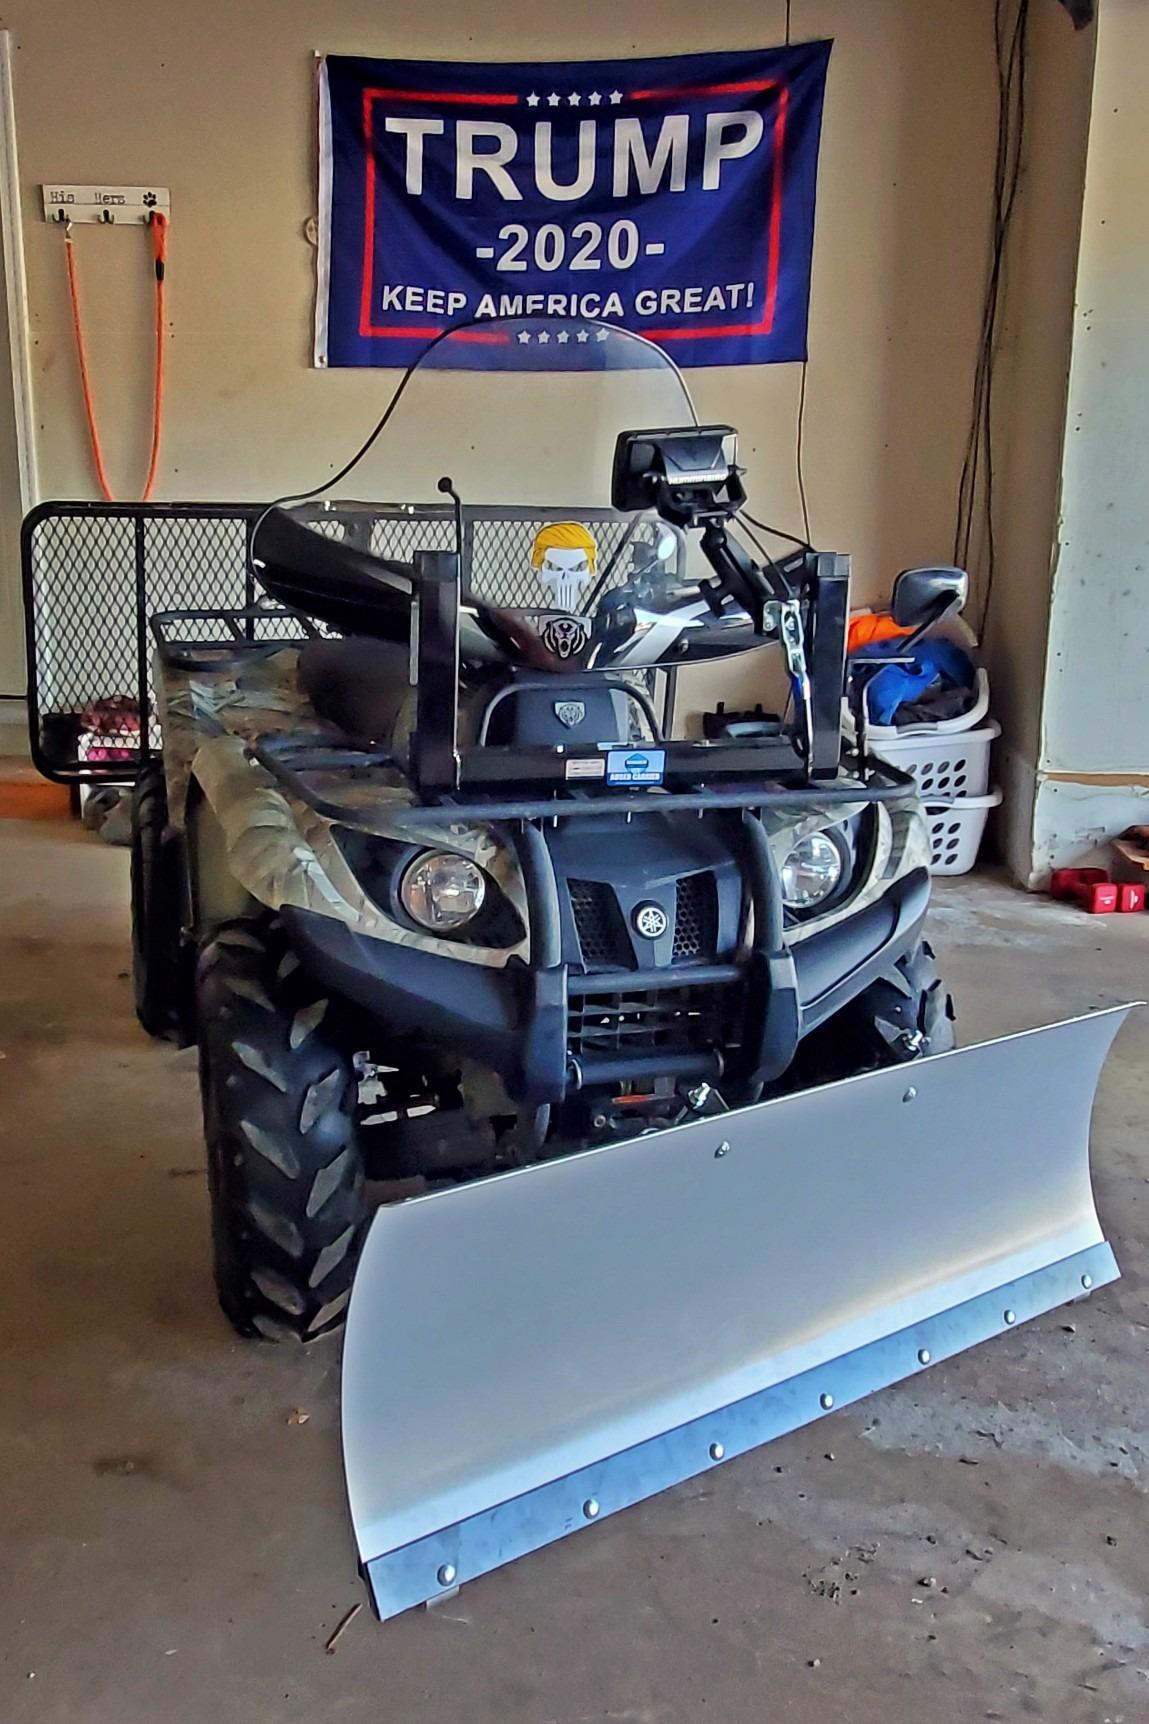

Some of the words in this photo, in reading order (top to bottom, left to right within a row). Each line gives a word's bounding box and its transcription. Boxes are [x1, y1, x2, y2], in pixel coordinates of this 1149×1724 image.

[385, 110, 764, 201] TRUMP
[382, 284, 467, 316] KEEP
[635, 282, 755, 316] GREAT!
